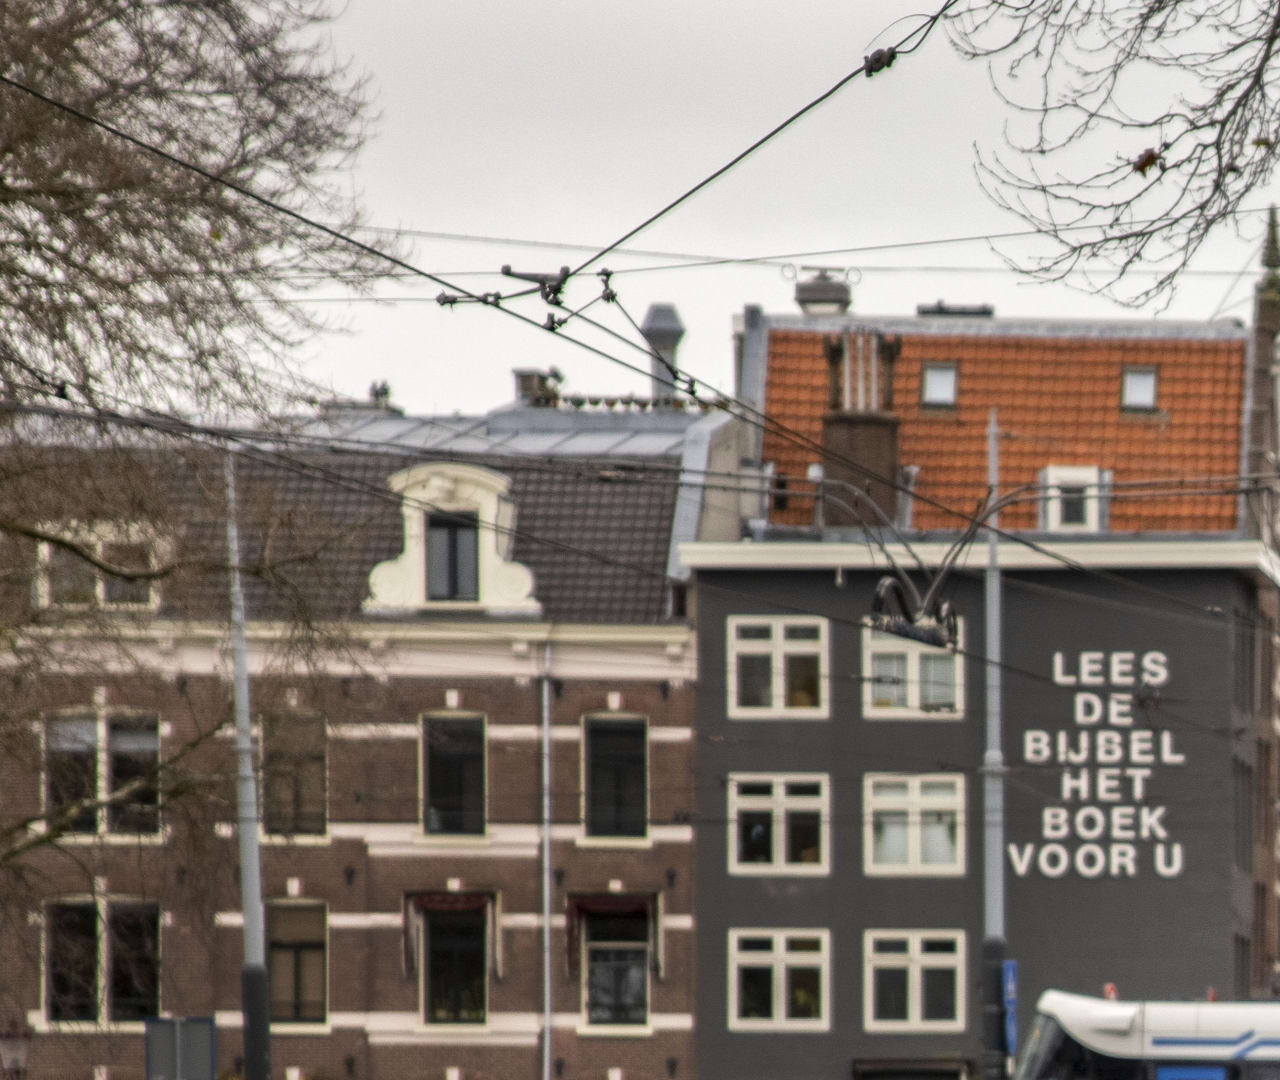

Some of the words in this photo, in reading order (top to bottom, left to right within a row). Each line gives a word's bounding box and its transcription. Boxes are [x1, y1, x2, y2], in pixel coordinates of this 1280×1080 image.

[1054, 652, 1168, 684] LEES
[1075, 693, 1132, 725] DE
[1025, 731, 1184, 763] BIJBEL
[1063, 769, 1151, 800] HET
[1043, 807, 1167, 839] BOEK
[1009, 844, 1136, 876] VOOR
[1156, 844, 1182, 876] U
